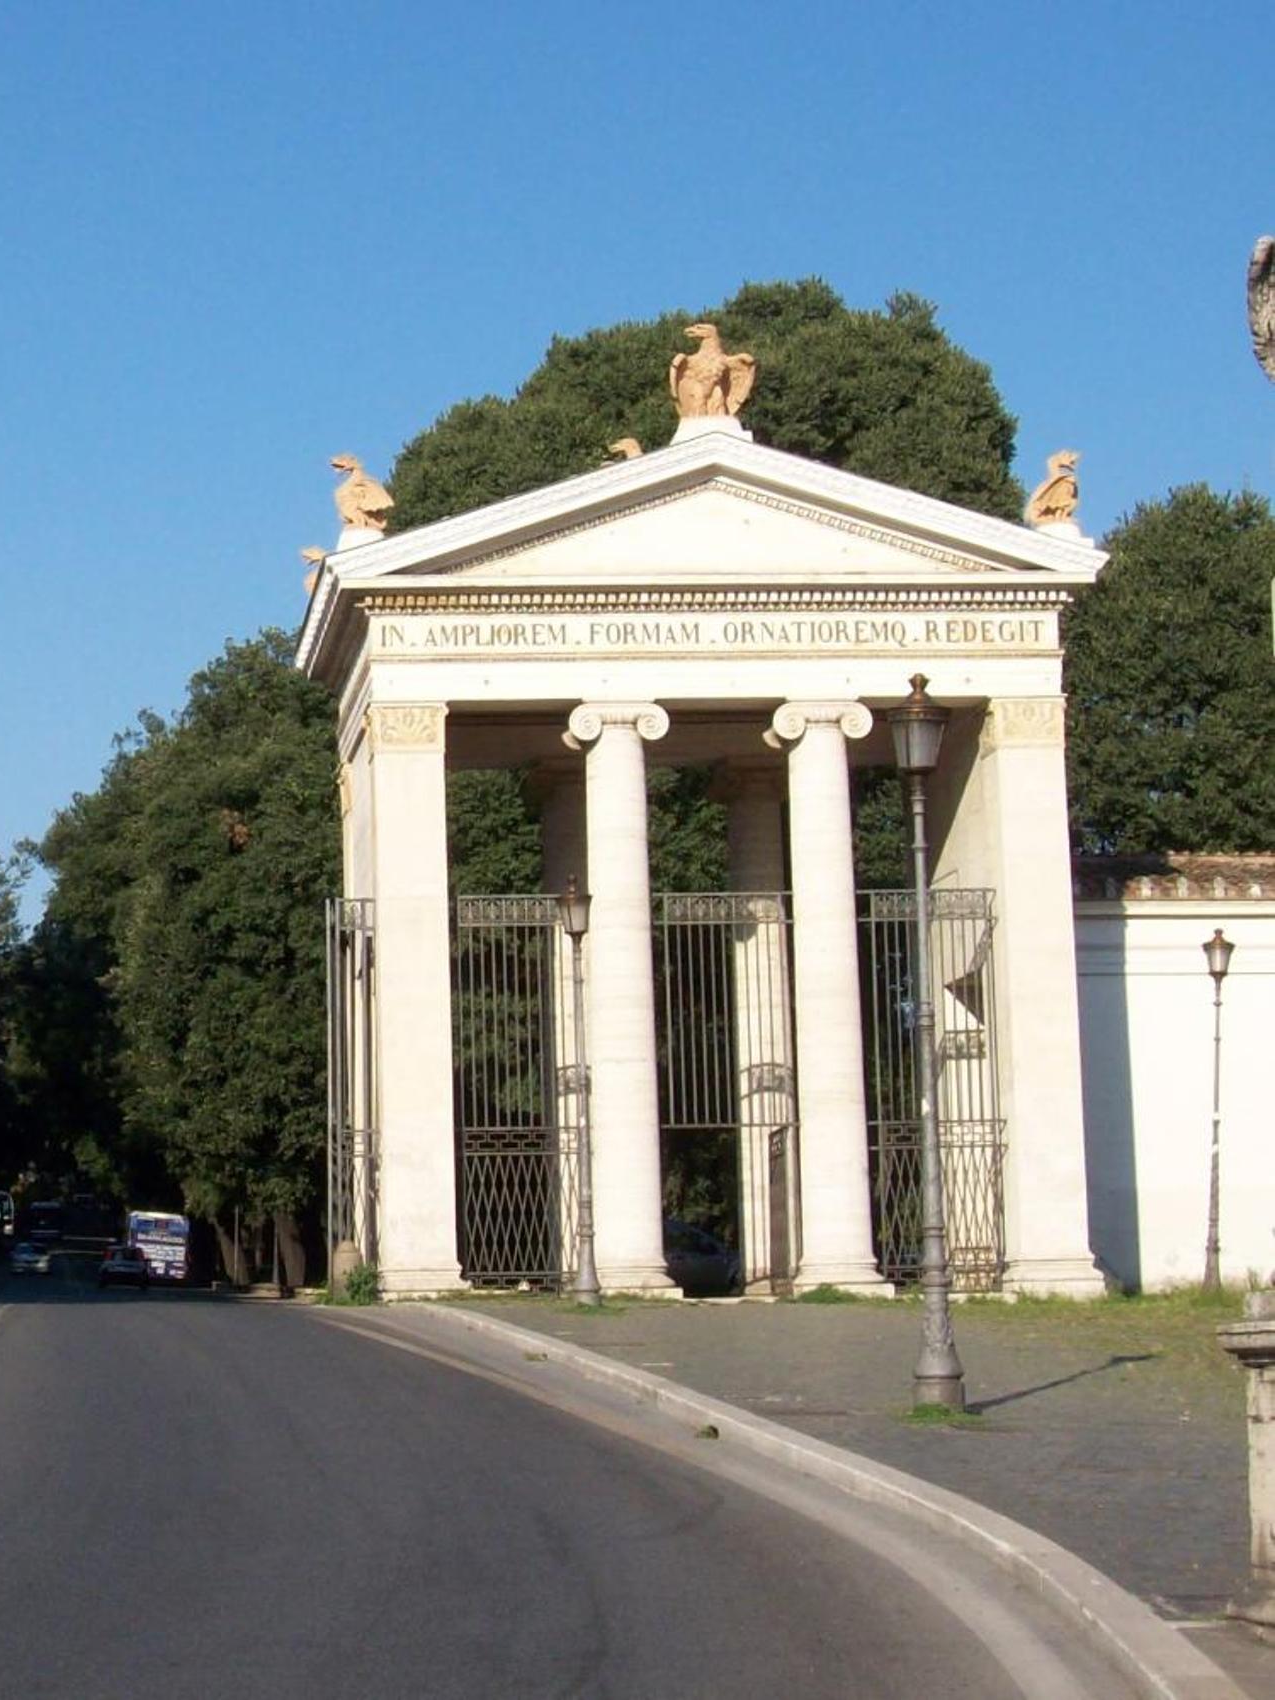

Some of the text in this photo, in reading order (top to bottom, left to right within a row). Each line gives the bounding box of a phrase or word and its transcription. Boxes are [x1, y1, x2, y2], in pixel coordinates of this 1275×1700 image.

[380, 625, 405, 647] IN
[424, 623, 567, 647] AMPLIOREM
[589, 622, 701, 645] FORMAM
[925, 620, 1044, 643] REDEGIT
